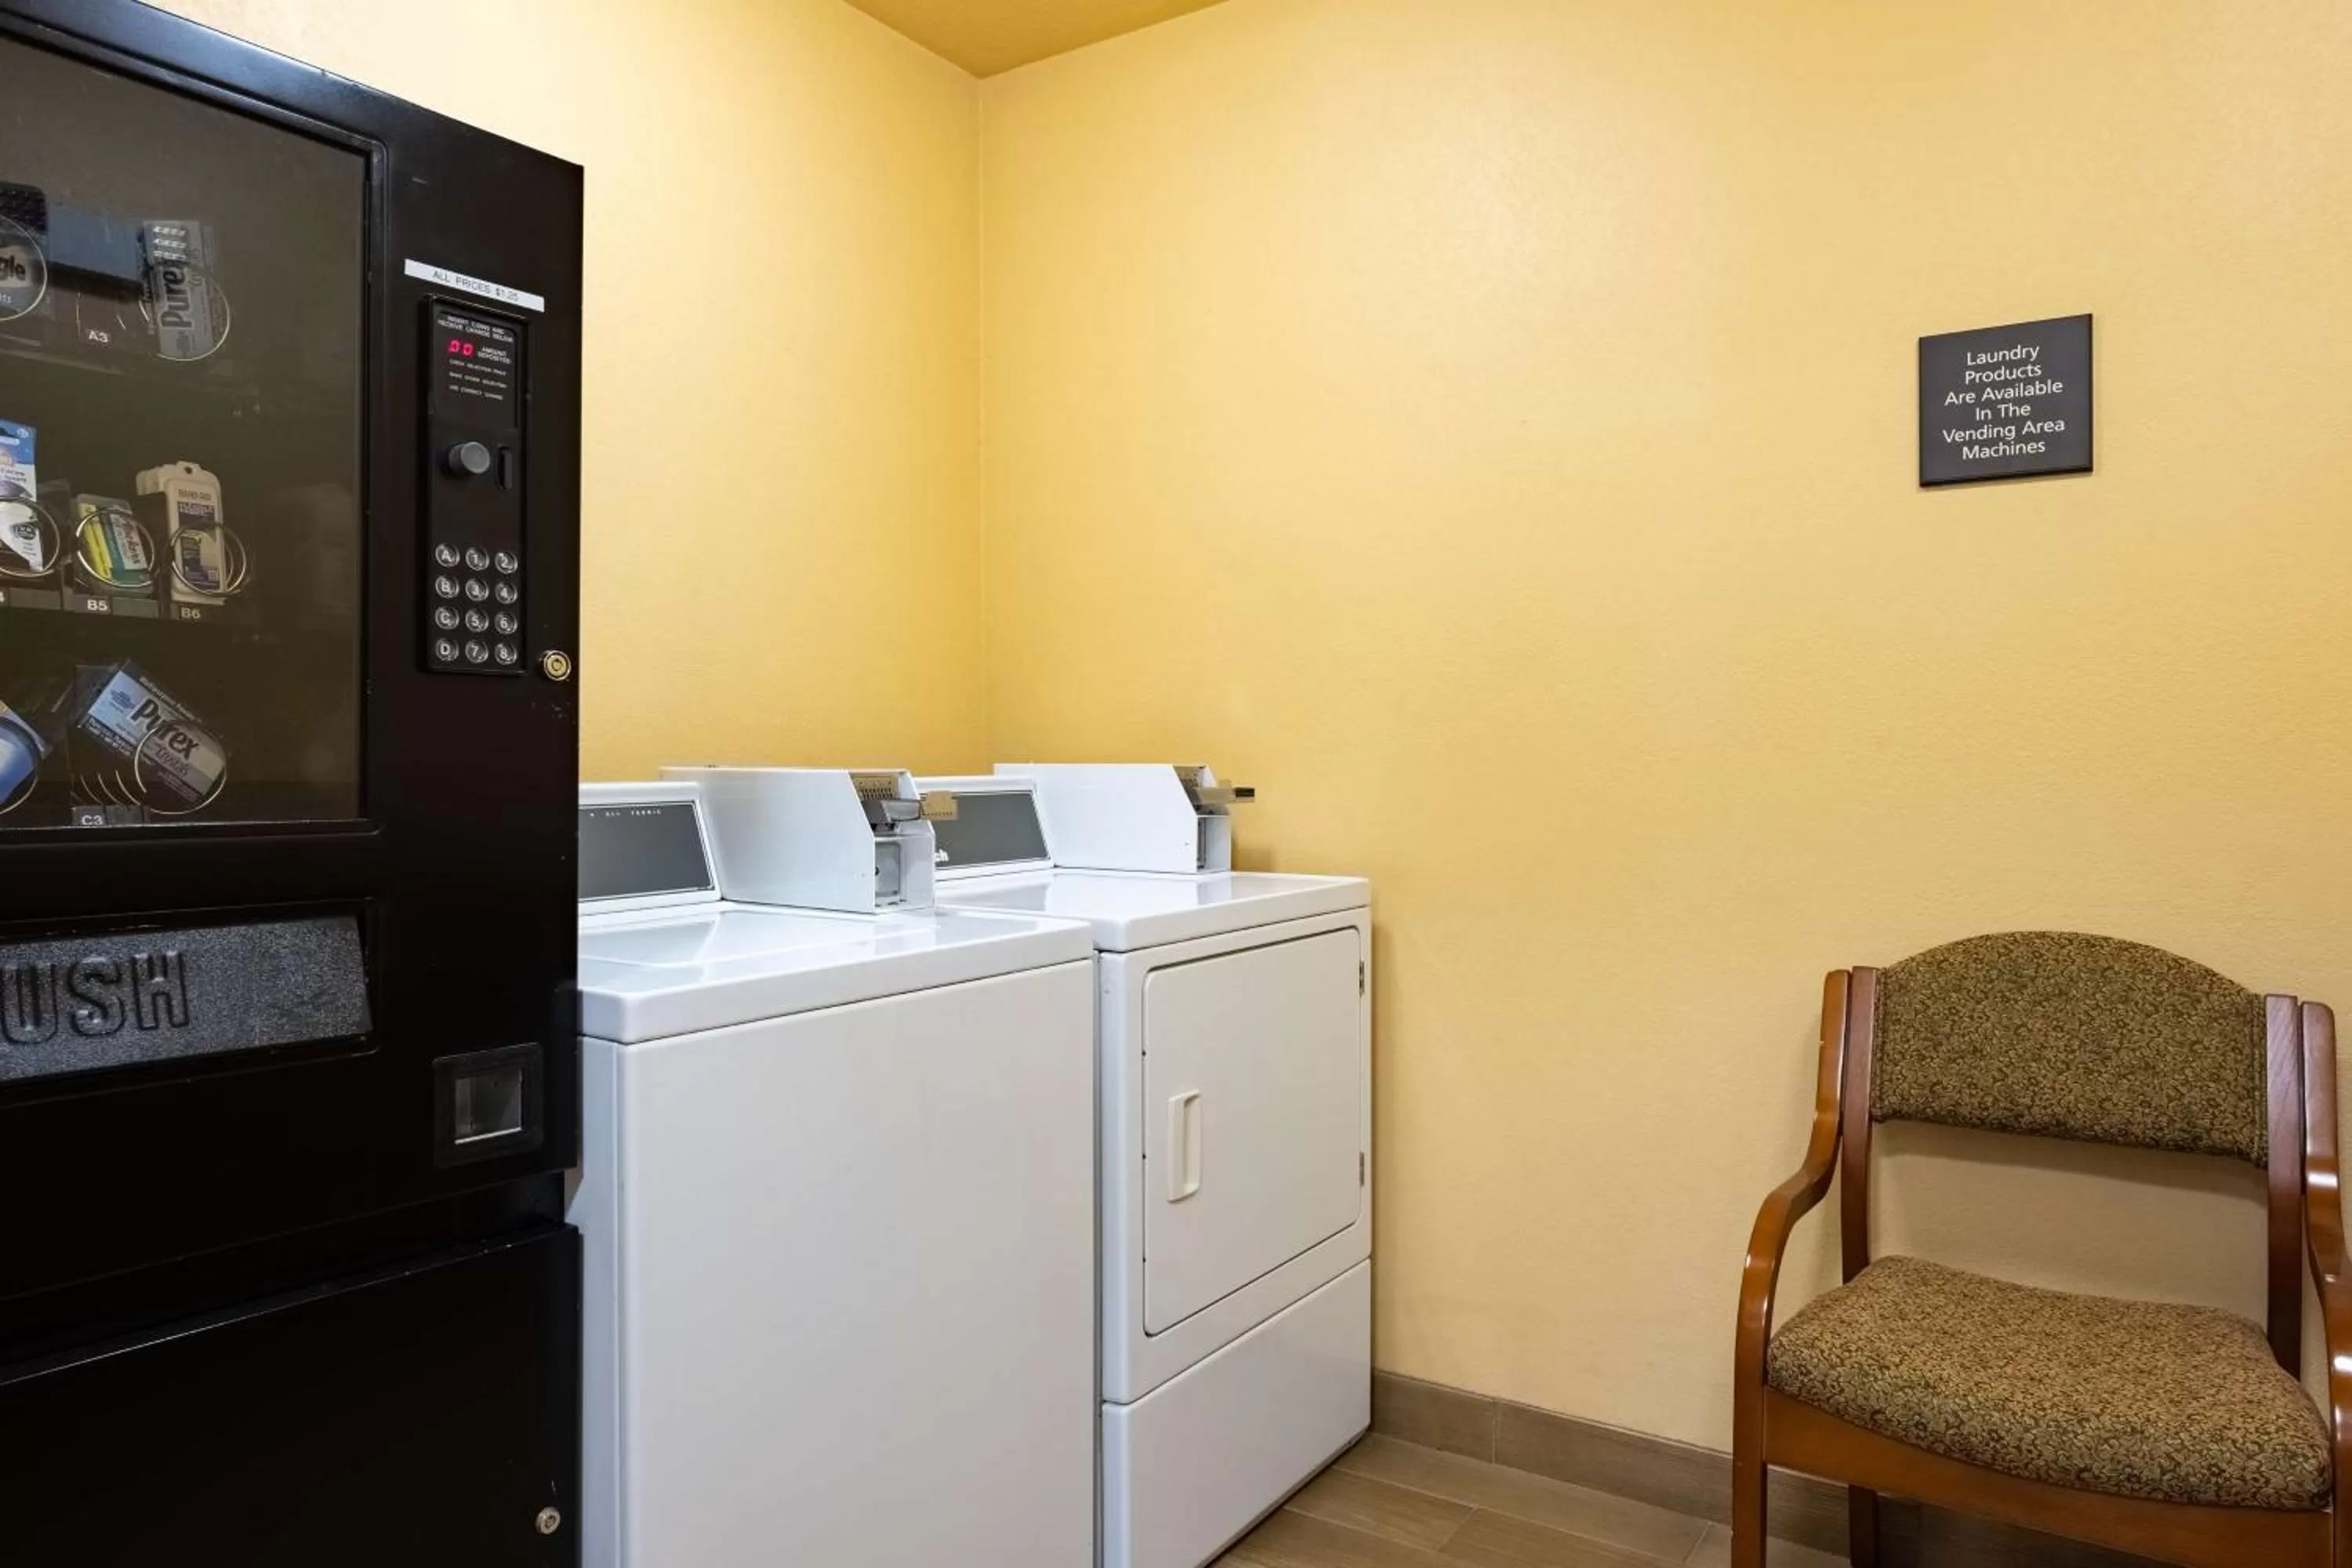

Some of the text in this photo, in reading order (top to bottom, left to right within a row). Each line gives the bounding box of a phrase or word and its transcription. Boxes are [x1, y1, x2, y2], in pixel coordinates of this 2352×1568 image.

[432, 269, 451, 283] ALL
[456, 275, 491, 293] PRICES
[87, 328, 110, 343] A3
[1966, 344, 2040, 366] Laundry
[1965, 363, 2042, 385] Products
[1944, 379, 2063, 406] Are Available
[1975, 402, 2031, 421] In The
[1941, 419, 2066, 444] Vending Area
[1962, 440, 2046, 461] Machines
[87, 599, 108, 612] B5
[180, 607, 201, 619] B6
[129, 697, 200, 760] Purex
[81, 815, 103, 826] C3
[0, 949, 191, 1045] USH
